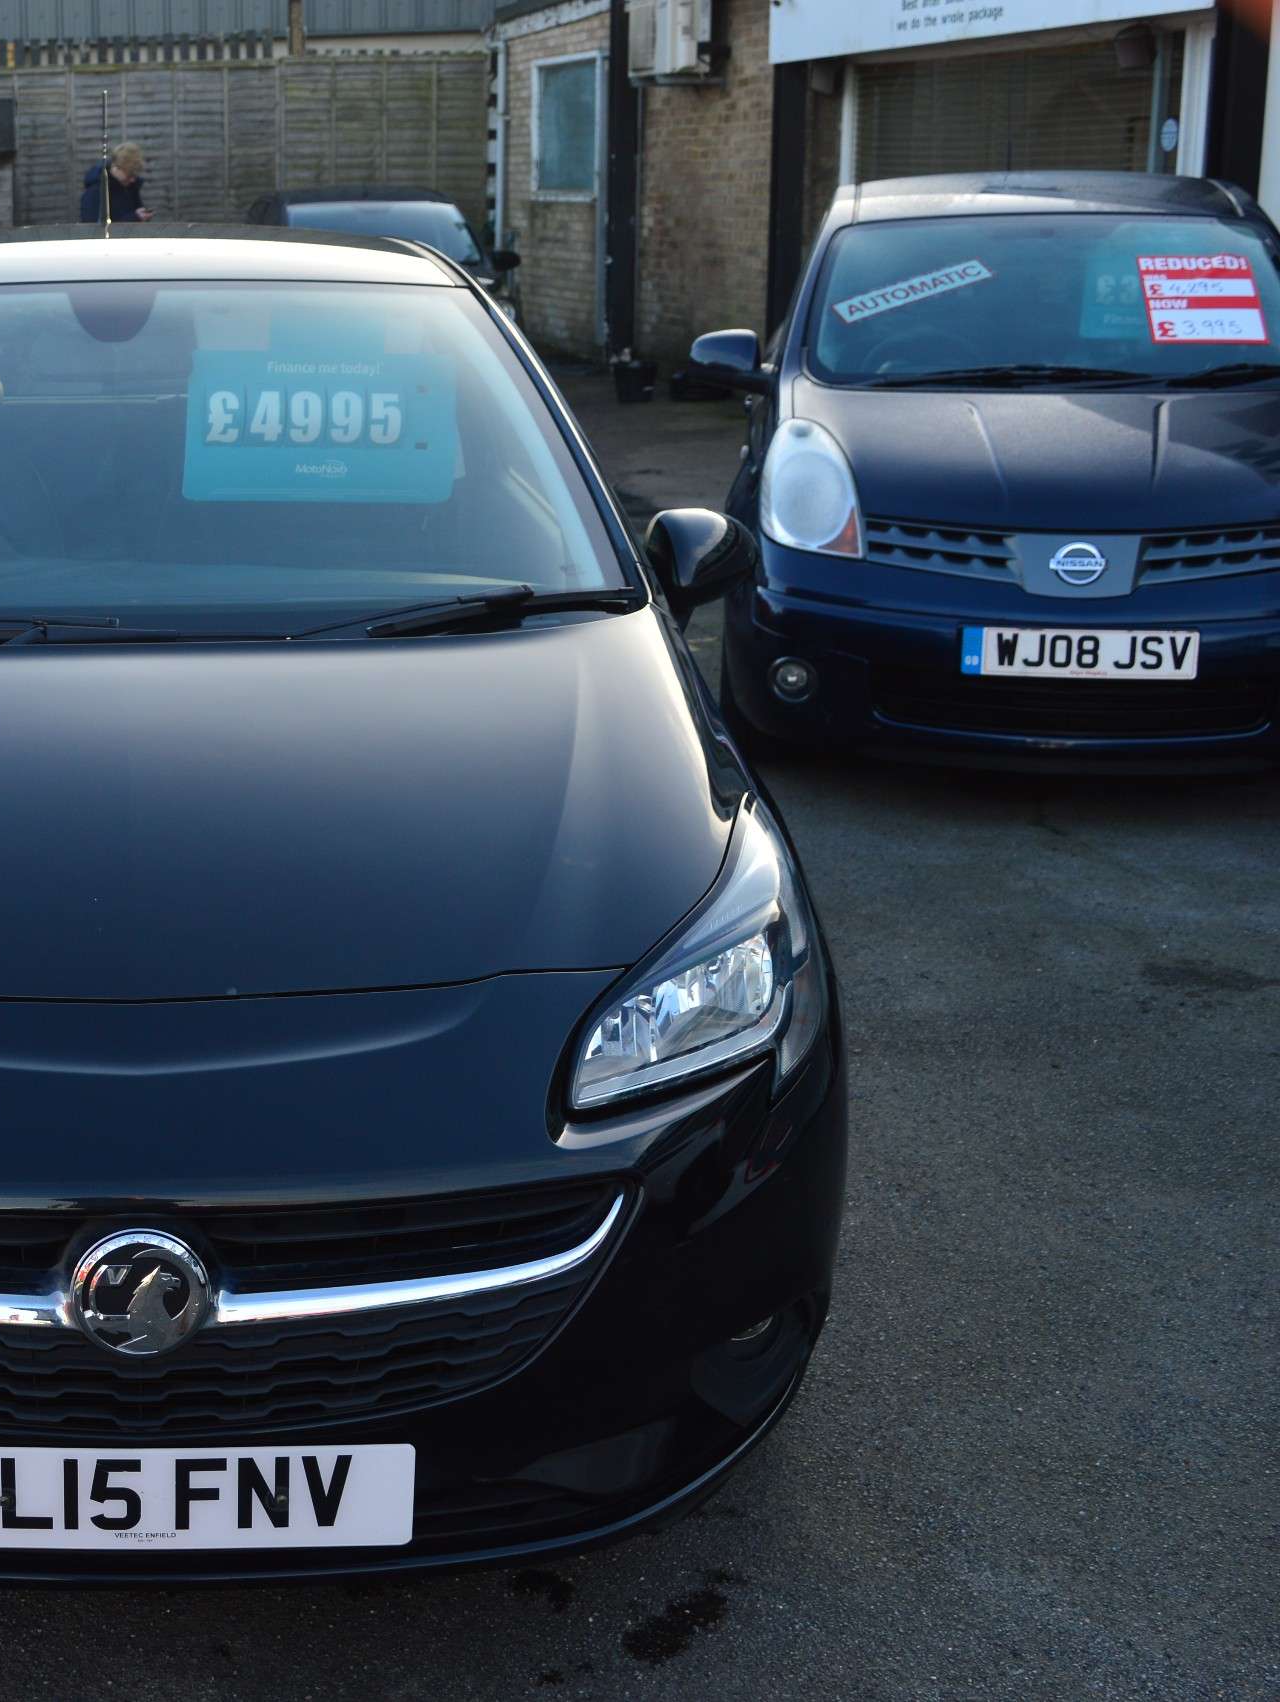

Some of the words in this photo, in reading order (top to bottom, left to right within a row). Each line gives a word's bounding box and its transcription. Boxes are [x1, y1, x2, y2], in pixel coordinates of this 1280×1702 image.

[1138, 255, 1248, 271] REDUCED!
[847, 265, 982, 316] AUTOMATIC
[1150, 299, 1188, 310] NOW
[267, 360, 316, 374] Finance
[319, 363, 337, 374] me
[205, 390, 403, 444] £4995
[1056, 559, 1103, 567] NISSAN
[997, 632, 1100, 669] WJ08
[1113, 635, 1192, 670] JSV
[175, 1454, 353, 1530] FNV
